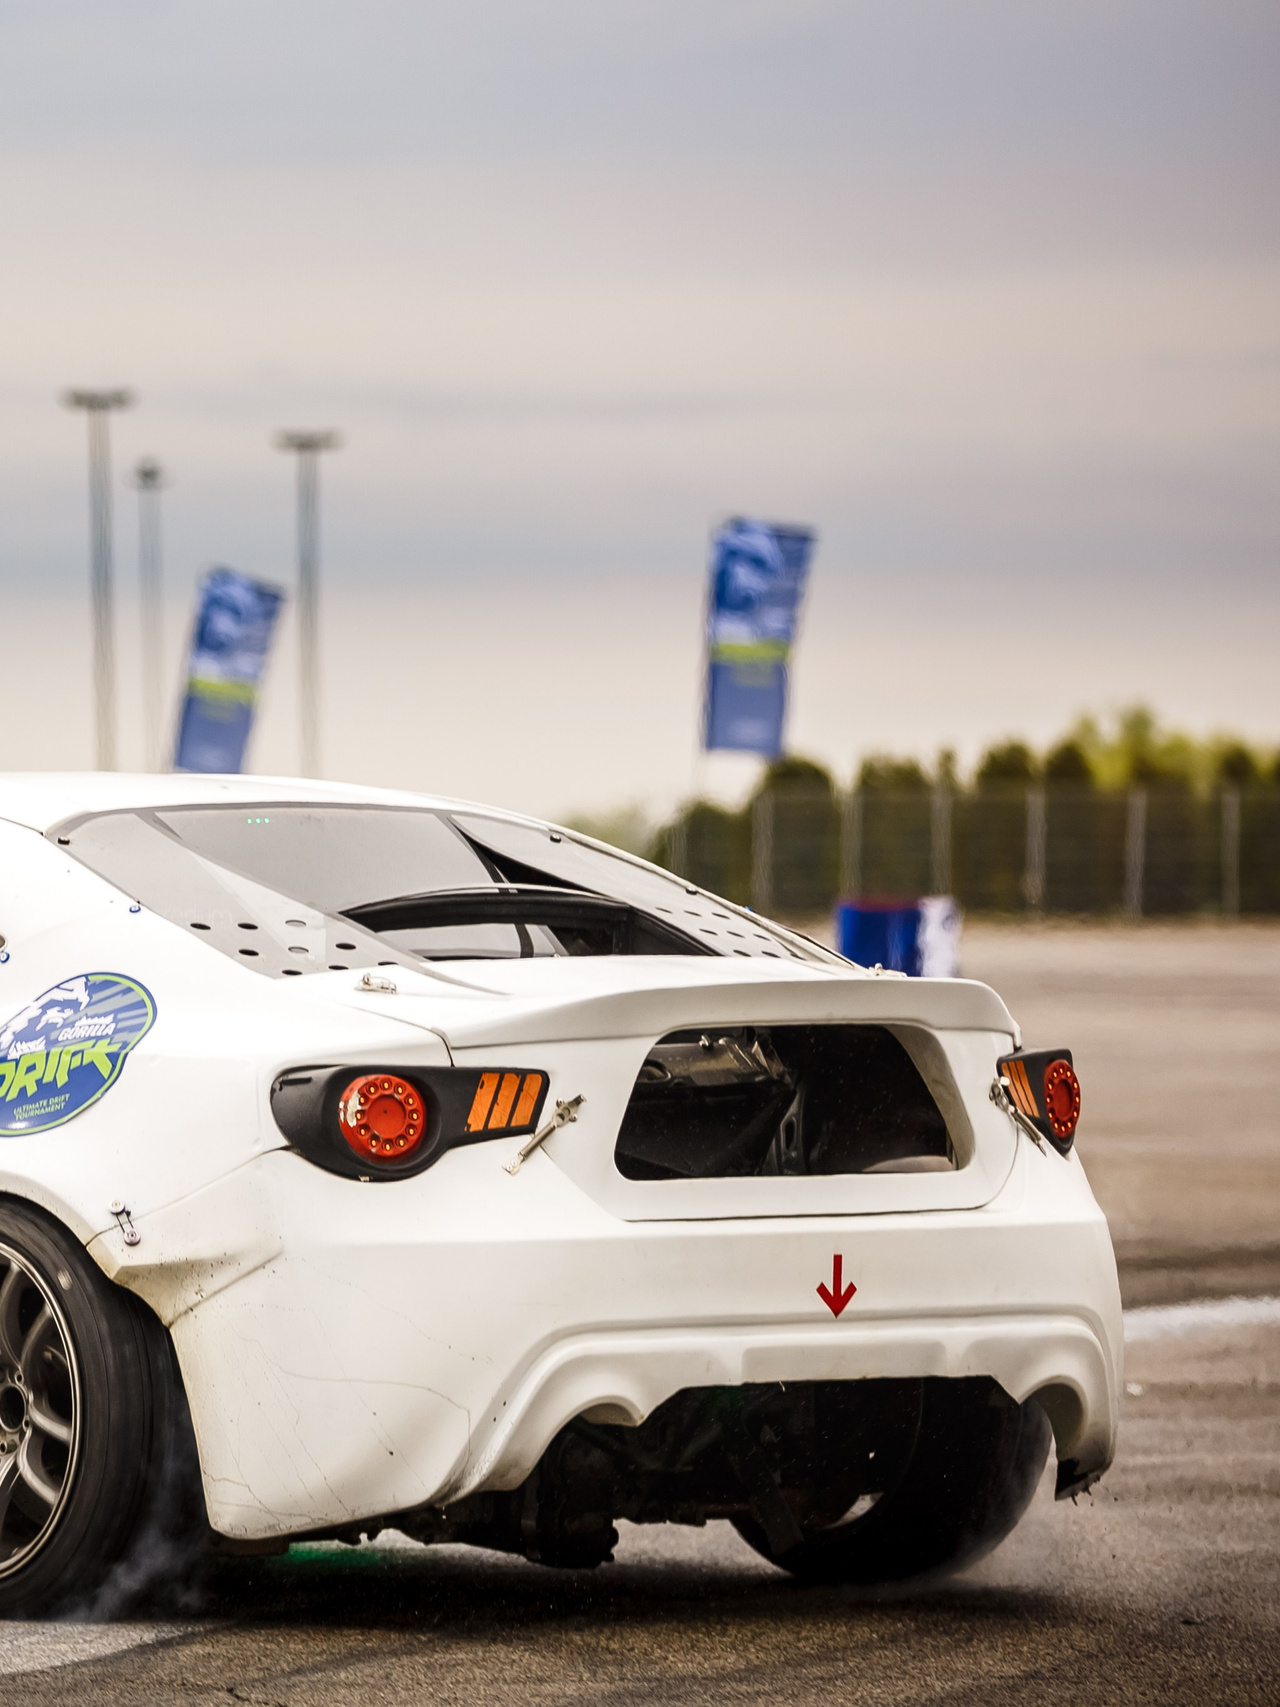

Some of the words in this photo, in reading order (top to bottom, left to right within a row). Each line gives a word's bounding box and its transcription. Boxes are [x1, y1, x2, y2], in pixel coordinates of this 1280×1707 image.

[58, 1023, 116, 1041] GORILLA
[14, 1099, 48, 1115] ULTIMATE
[49, 1093, 70, 1105] DRIFT
[15, 1102, 65, 1121] TOURNAMENT
